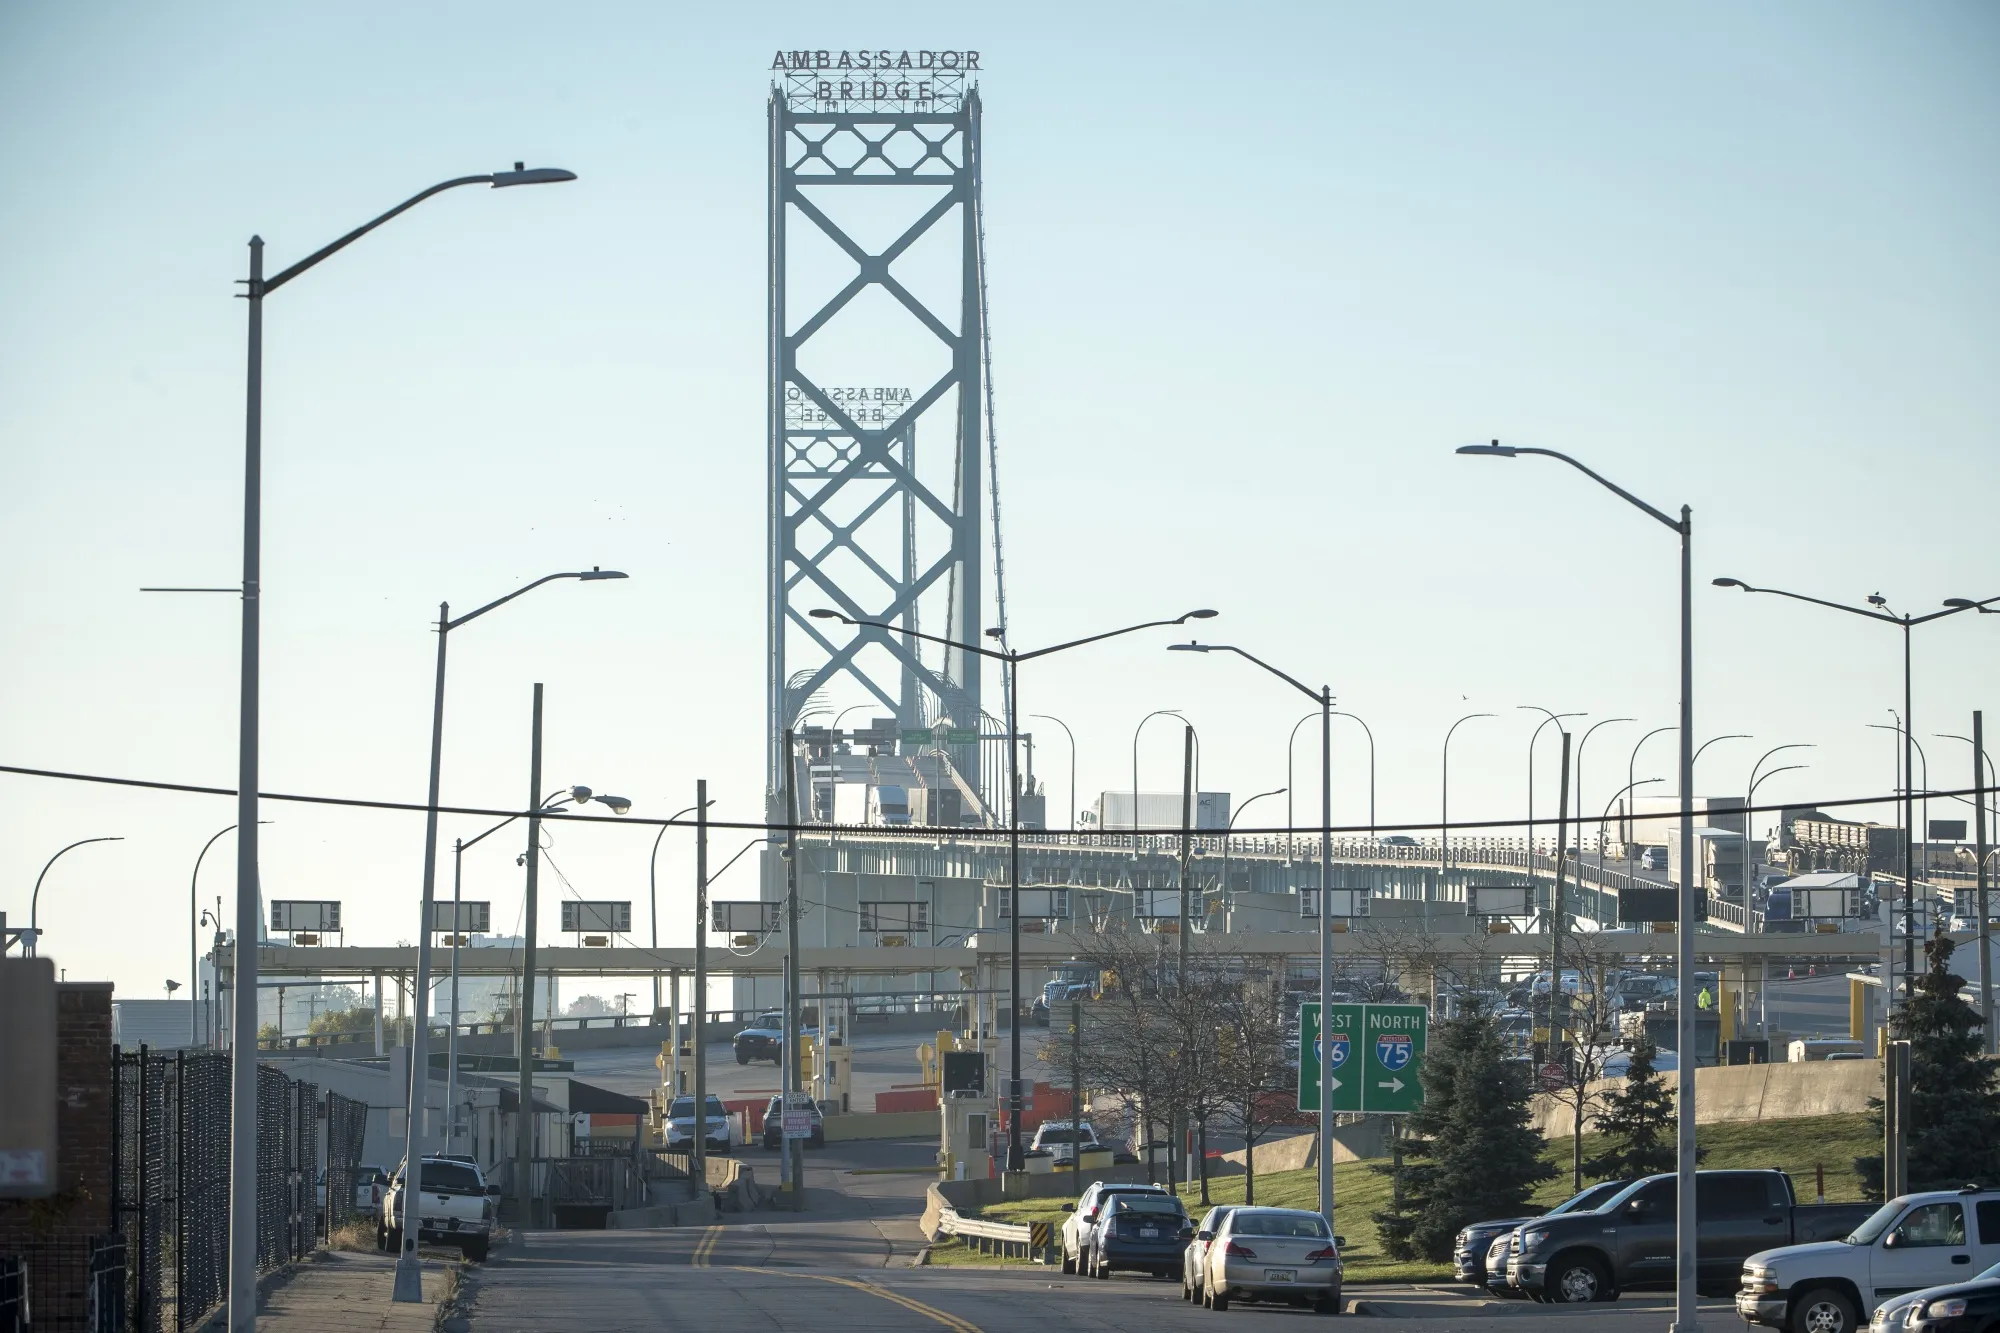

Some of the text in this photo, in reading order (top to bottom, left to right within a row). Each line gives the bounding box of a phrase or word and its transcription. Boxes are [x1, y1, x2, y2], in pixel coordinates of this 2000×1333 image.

[772, 50, 980, 69] AMBASSADOR
[818, 81, 932, 100] BRIDGE
[1370, 1013, 1420, 1030] NORTH
[1379, 1043, 1409, 1064] 75
